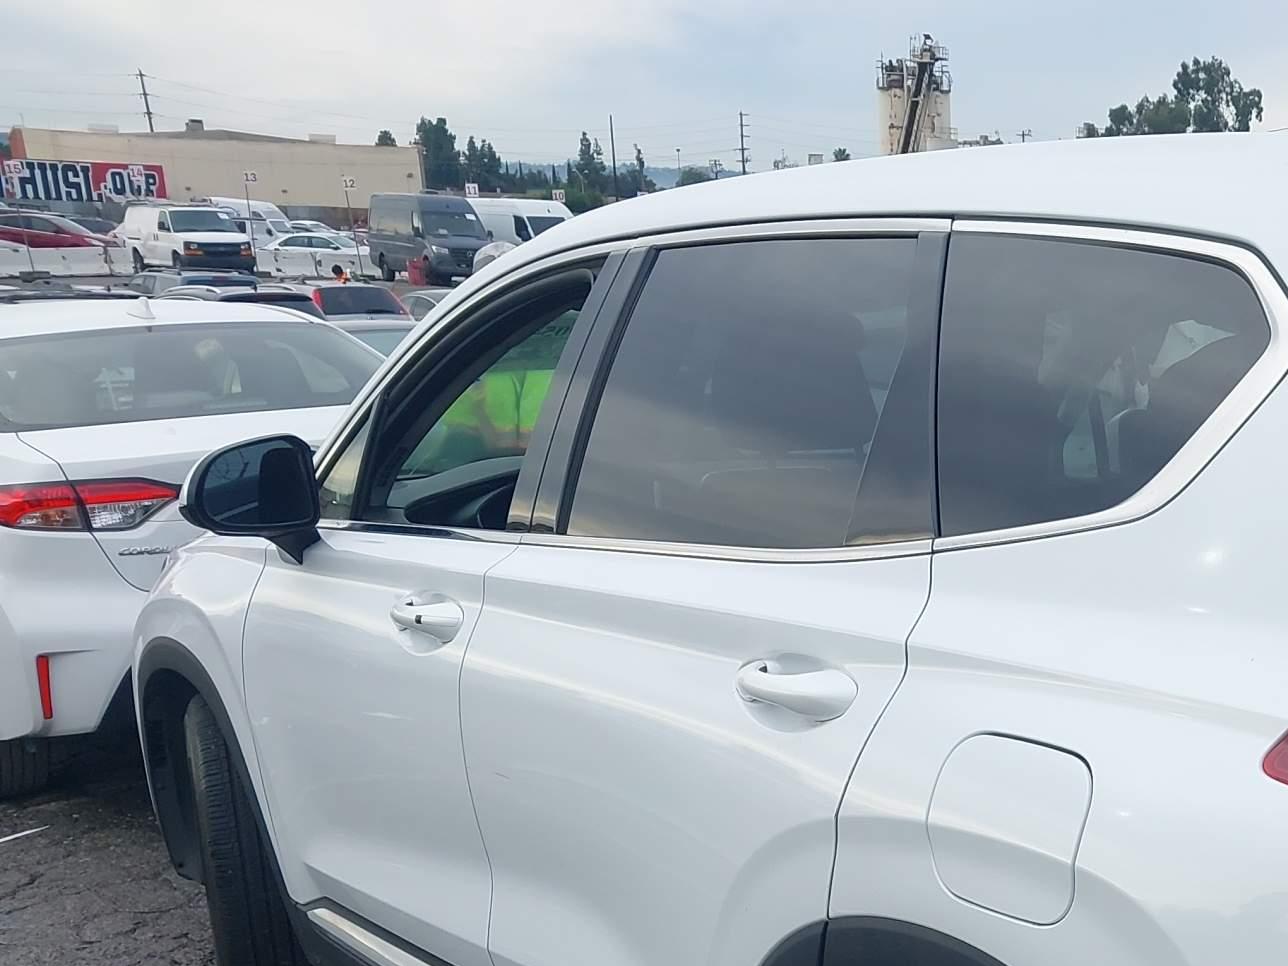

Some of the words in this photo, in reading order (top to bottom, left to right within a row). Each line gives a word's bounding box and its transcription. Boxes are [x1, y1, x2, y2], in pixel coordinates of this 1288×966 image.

[6, 163, 21, 174] 15
[131, 167, 143, 178] 14
[244, 172, 257, 182] 13
[343, 178, 355, 188] 12
[466, 185, 478, 196] 11
[552, 191, 565, 201] 10
